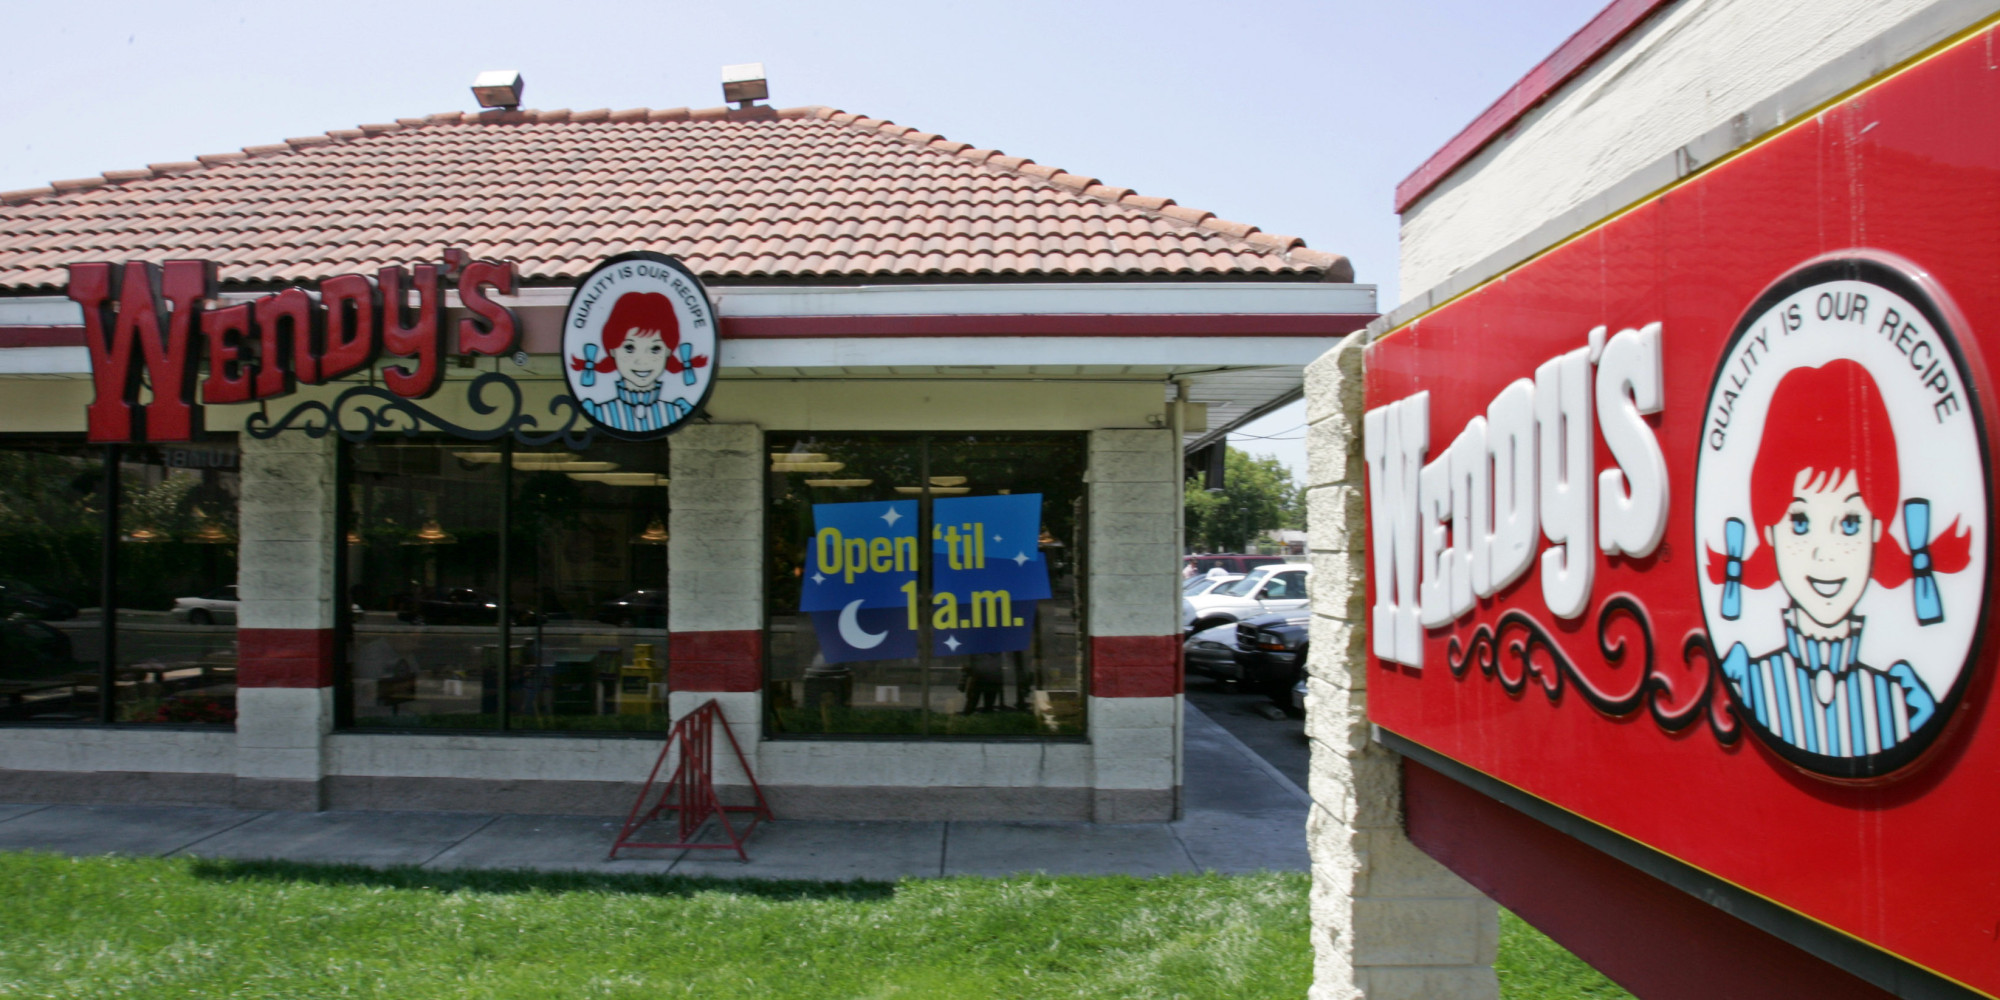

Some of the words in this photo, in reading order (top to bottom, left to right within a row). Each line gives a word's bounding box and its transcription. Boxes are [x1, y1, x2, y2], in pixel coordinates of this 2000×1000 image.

[574, 273, 616, 329] QUALITY
[618, 266, 633, 279] IS
[637, 264, 670, 283] OUR
[670, 278, 707, 329] RECIPE
[1709, 327, 1770, 452] QUALITY
[1780, 303, 1802, 336] IS
[1816, 291, 1869, 325] OUR
[1868, 306, 1961, 425] RECIPE
[816, 526, 918, 584] Open
[900, 580, 918, 630] 1
[931, 589, 1024, 630] a.m.
